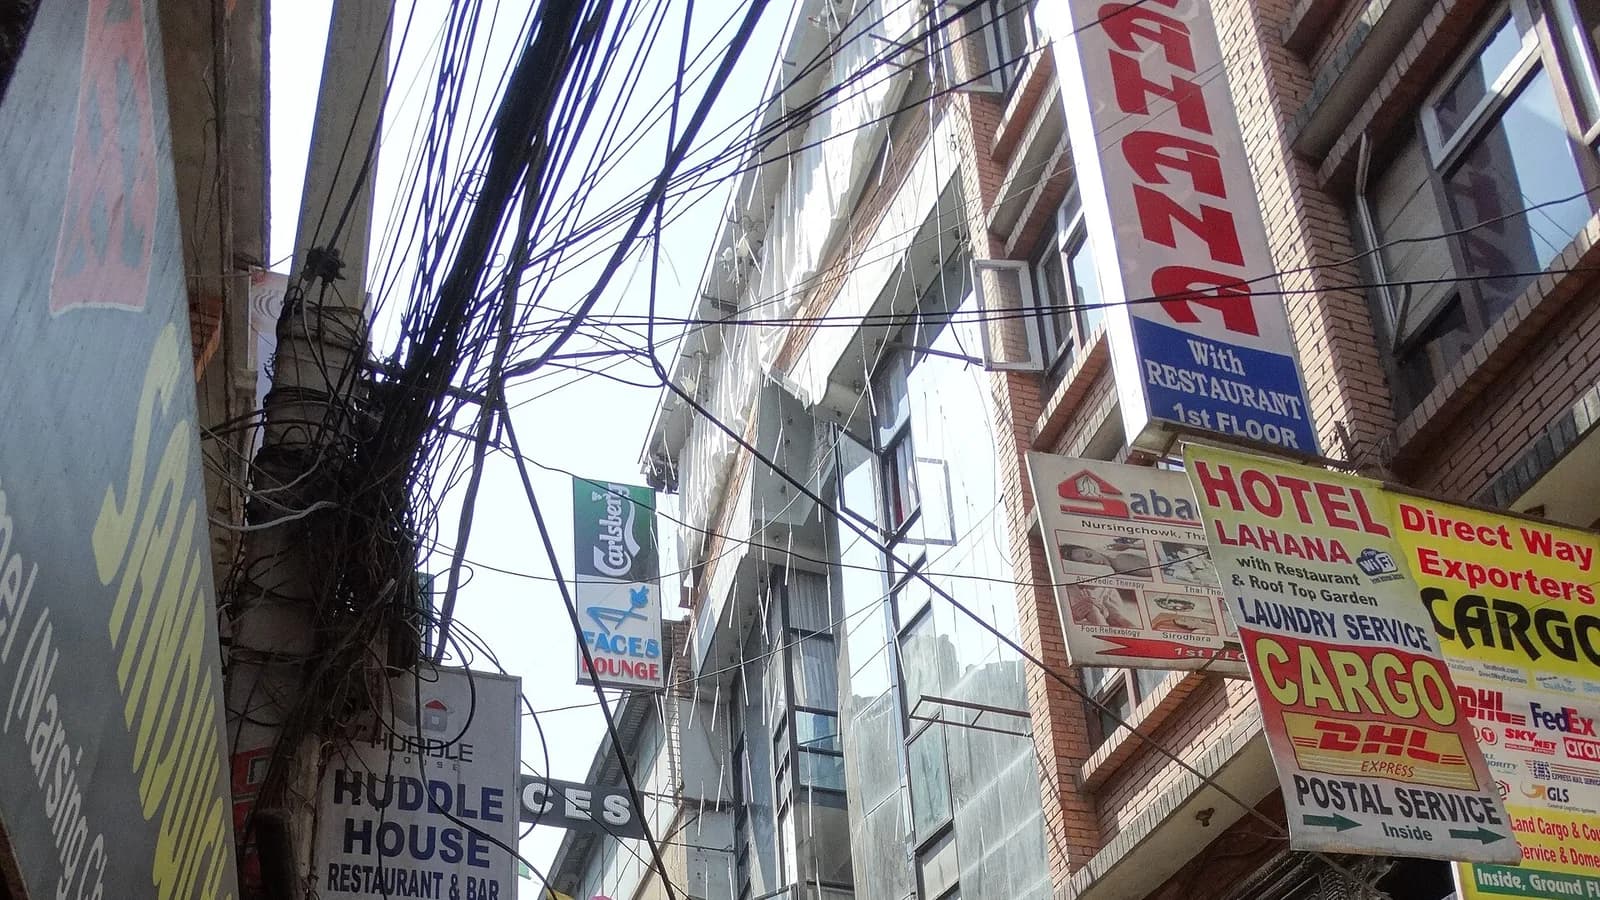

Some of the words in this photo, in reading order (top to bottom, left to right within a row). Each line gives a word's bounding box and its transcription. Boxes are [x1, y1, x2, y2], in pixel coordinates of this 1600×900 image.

[1187, 339, 1246, 377] With
[1144, 359, 1301, 420] RESTAURANT
[1173, 402, 1212, 428] 1st
[1216, 411, 1299, 449] FLOOR
[1194, 461, 1391, 538] HOTEL
[593, 483, 637, 577] Carlsberg
[1081, 519, 1182, 539] Nursingchowk,
[1214, 519, 1353, 565] LAHANA
[1400, 504, 1513, 550] Direct
[1520, 527, 1593, 571] Way
[1236, 555, 1272, 573] with
[1274, 561, 1361, 586] Restaurant
[1417, 547, 1596, 606] Exporters
[1231, 573, 1246, 587] &
[1249, 575, 1285, 594] Roof
[1288, 582, 1317, 602] Top
[1320, 589, 1379, 607] Garden
[1080, 624, 1098, 633] Foot
[1162, 631, 1212, 643] Sirodhara
[1237, 596, 1338, 639] LAUNDRY
[1343, 613, 1433, 653] SERVICE
[583, 630, 660, 659] FACES
[1174, 647, 1203, 657] 1st
[1255, 637, 1457, 727] CARGO
[1456, 685, 1512, 724] DHL
[1530, 702, 1598, 737] FedEx
[1314, 720, 1441, 763] DHL
[1504, 727, 1537, 741] SKY
[1361, 760, 1416, 778] EXPRESS
[333, 769, 504, 824] HUDDLE
[1293, 773, 1394, 816] POSTAL
[1394, 786, 1503, 826] SERVICE
[1547, 786, 1570, 803] GLS
[343, 818, 490, 868] HOUSE
[1381, 821, 1433, 842] Inside
[1508, 813, 1537, 833] Land
[1538, 817, 1569, 841] Cargo
[1571, 821, 1581, 839] &
[1559, 846, 1569, 864] &
[327, 863, 444, 900] RESTAURANT
[448, 874, 461, 900] &
[467, 876, 499, 900] BAR
[1477, 868, 1526, 891] Inside,
[1529, 874, 1583, 896] Ground
